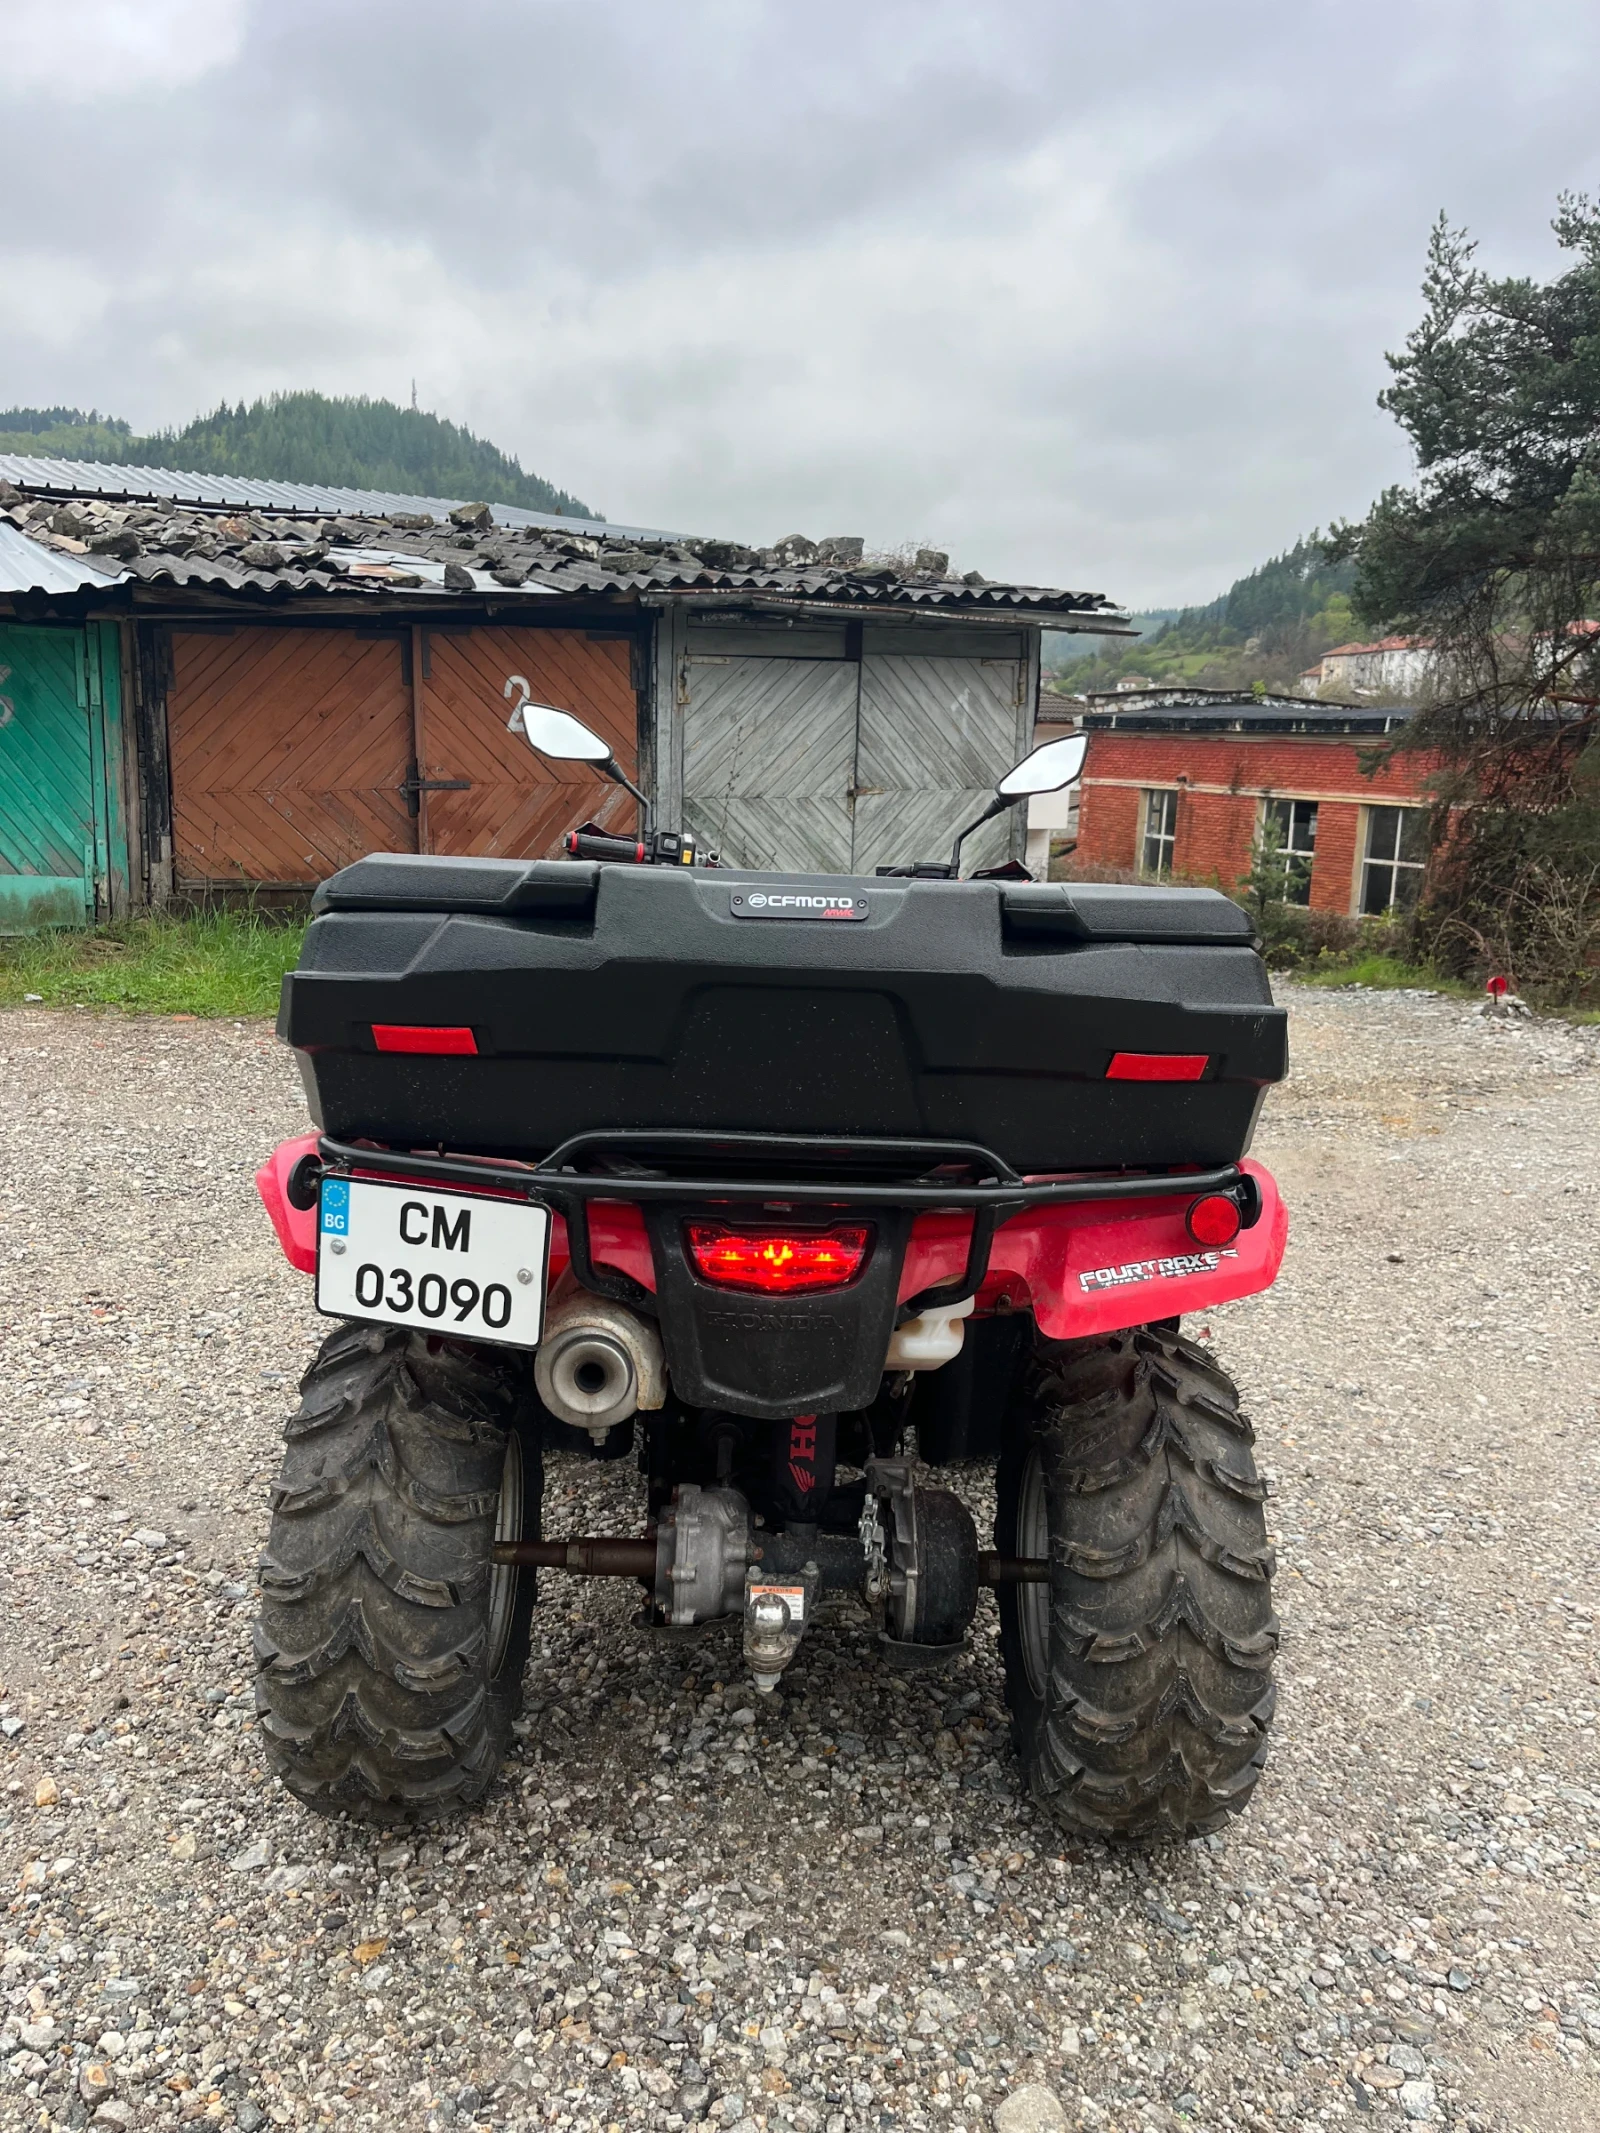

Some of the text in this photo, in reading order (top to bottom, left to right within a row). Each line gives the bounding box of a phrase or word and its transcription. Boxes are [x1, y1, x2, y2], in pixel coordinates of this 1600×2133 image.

[503, 675, 531, 733] 2
[768, 895, 853, 908] CFMOTO
[324, 1213, 345, 1229] BG
[400, 1201, 471, 1252] CM
[355, 1263, 512, 1329] 03090
[706, 1311, 844, 1331] HONDA
